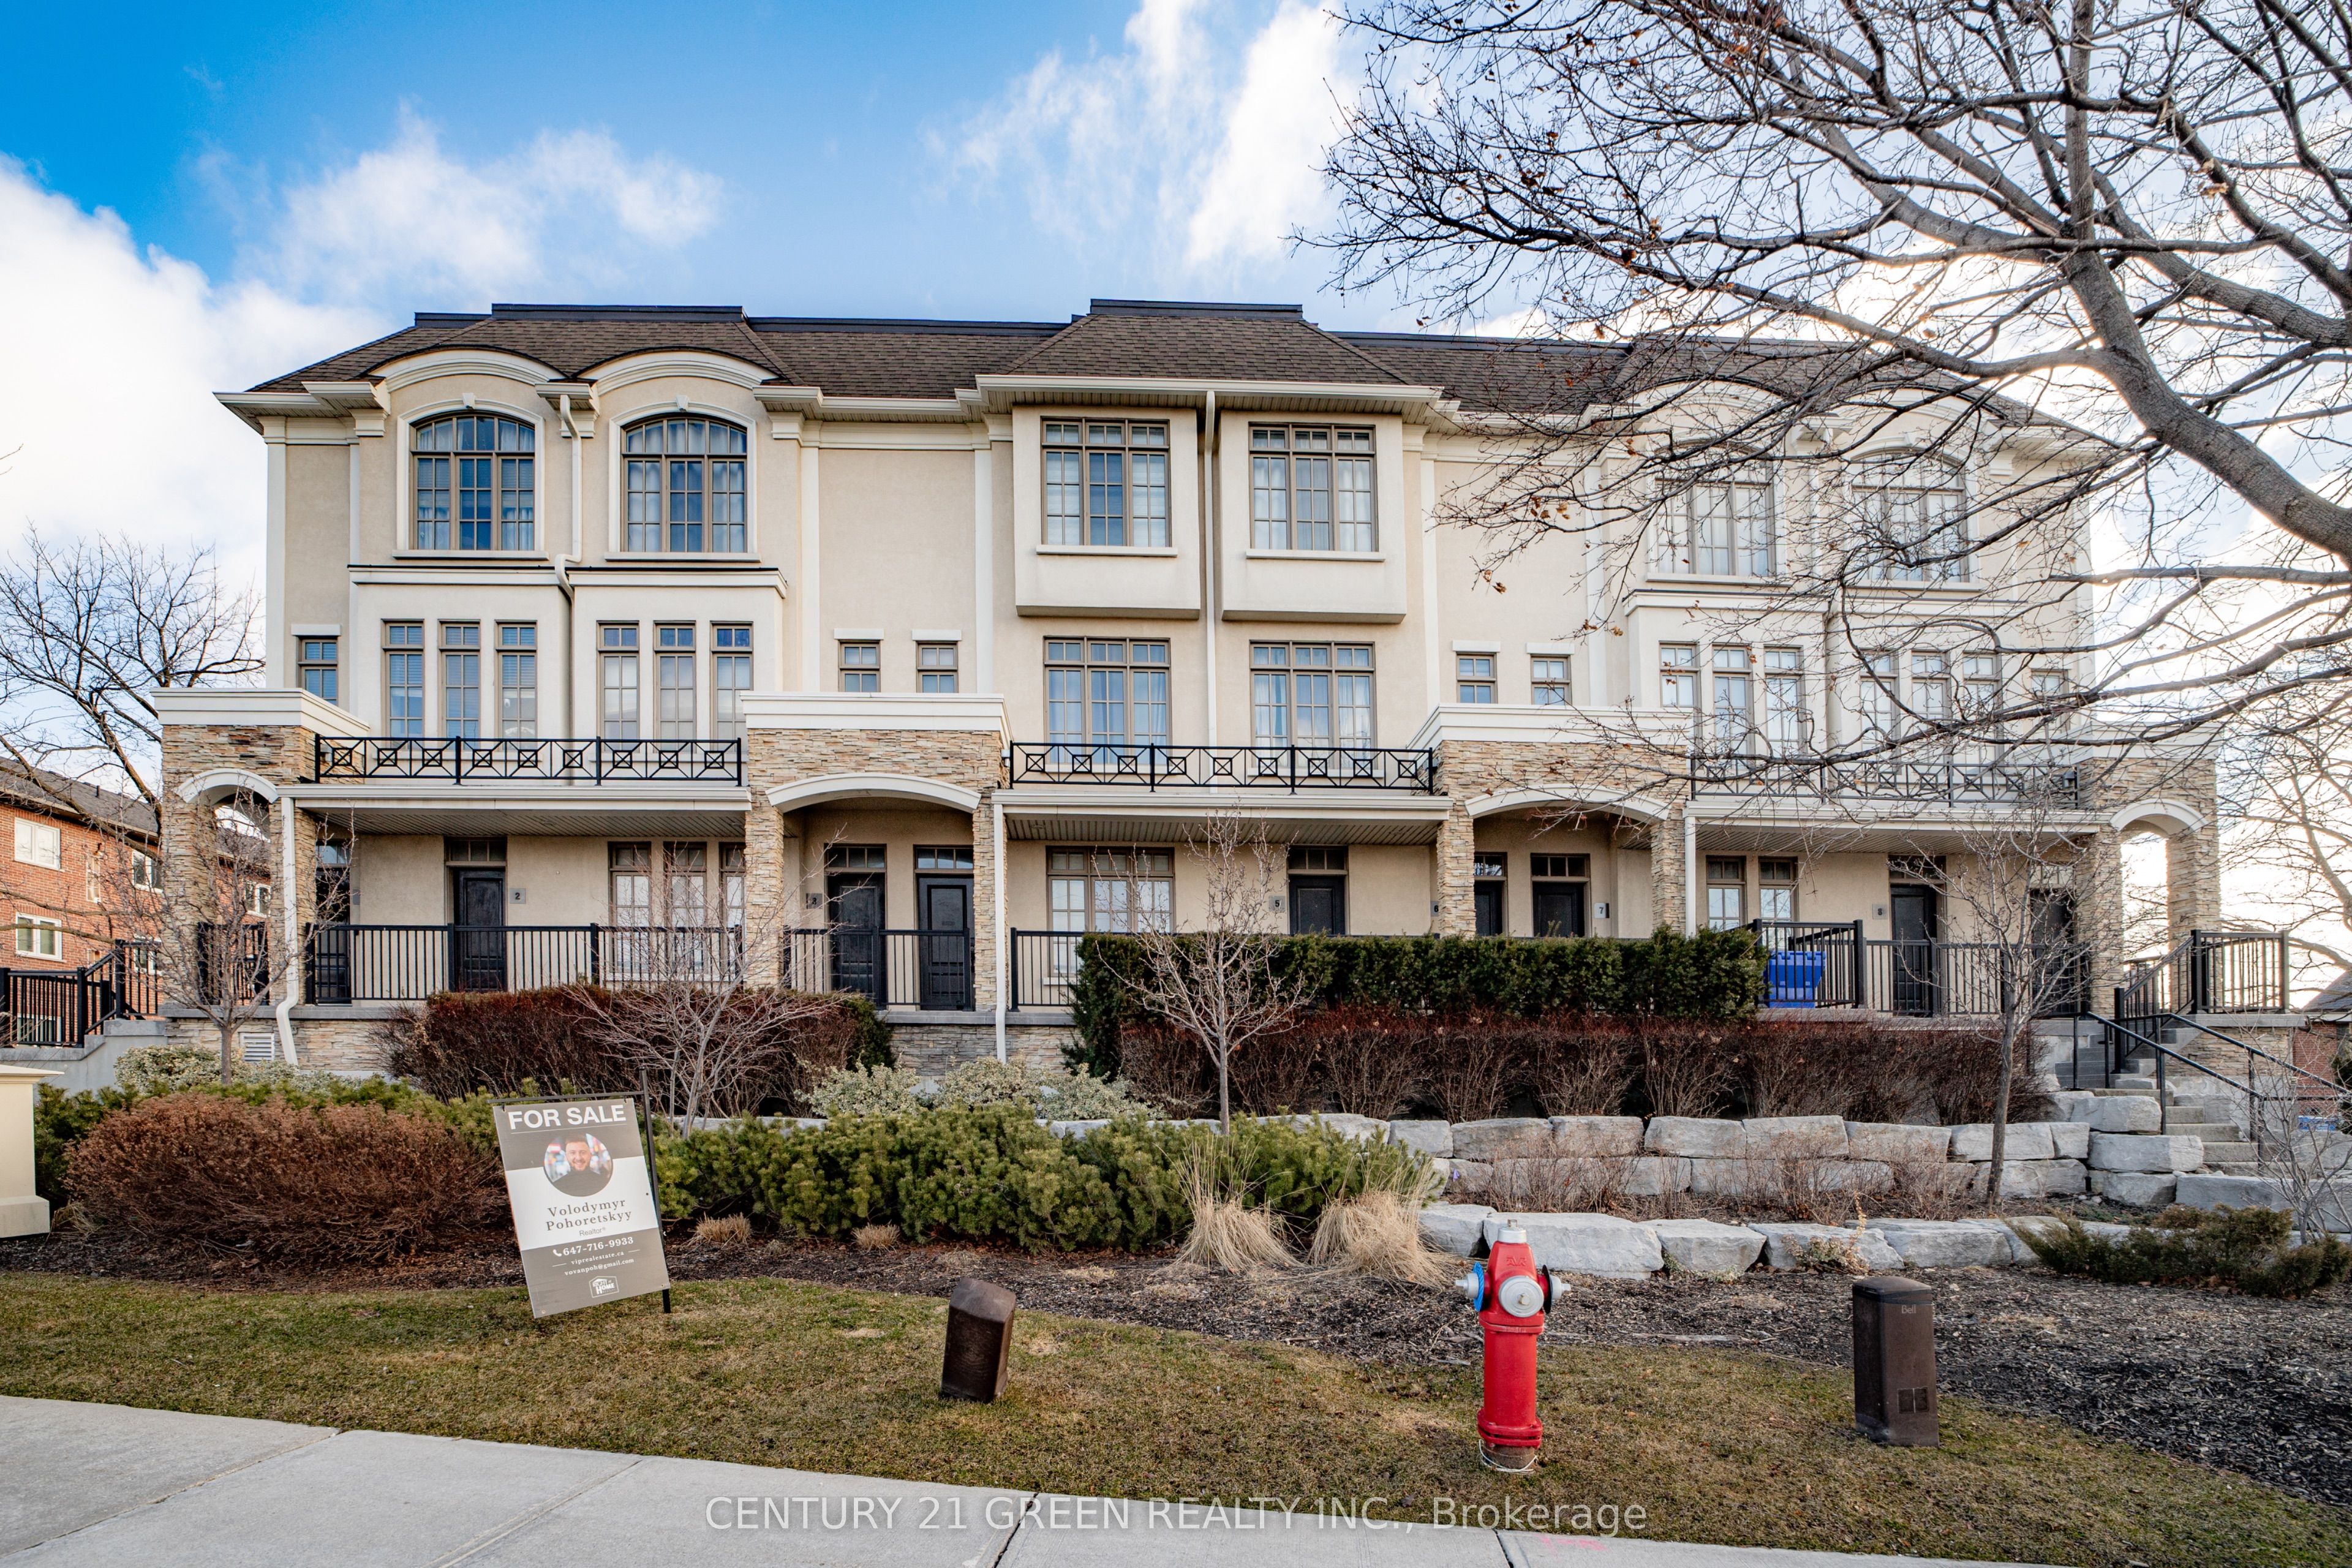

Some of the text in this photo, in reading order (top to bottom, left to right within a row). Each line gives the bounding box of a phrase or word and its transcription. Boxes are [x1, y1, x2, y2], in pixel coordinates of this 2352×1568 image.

[514, 892, 521, 900] 2
[508, 1104, 627, 1130] FOR SALE
[548, 1199, 625, 1218] Volodymyr
[546, 1211, 632, 1231] Pohoretskyy
[563, 1236, 634, 1256] 647-716-9933
[564, 1258, 635, 1276] vovanpoh@gmail.com
[571, 1251, 625, 1265] viprealestate.ca
[595, 1283, 616, 1295] HOME
[1901, 1304, 1917, 1314] Bell
